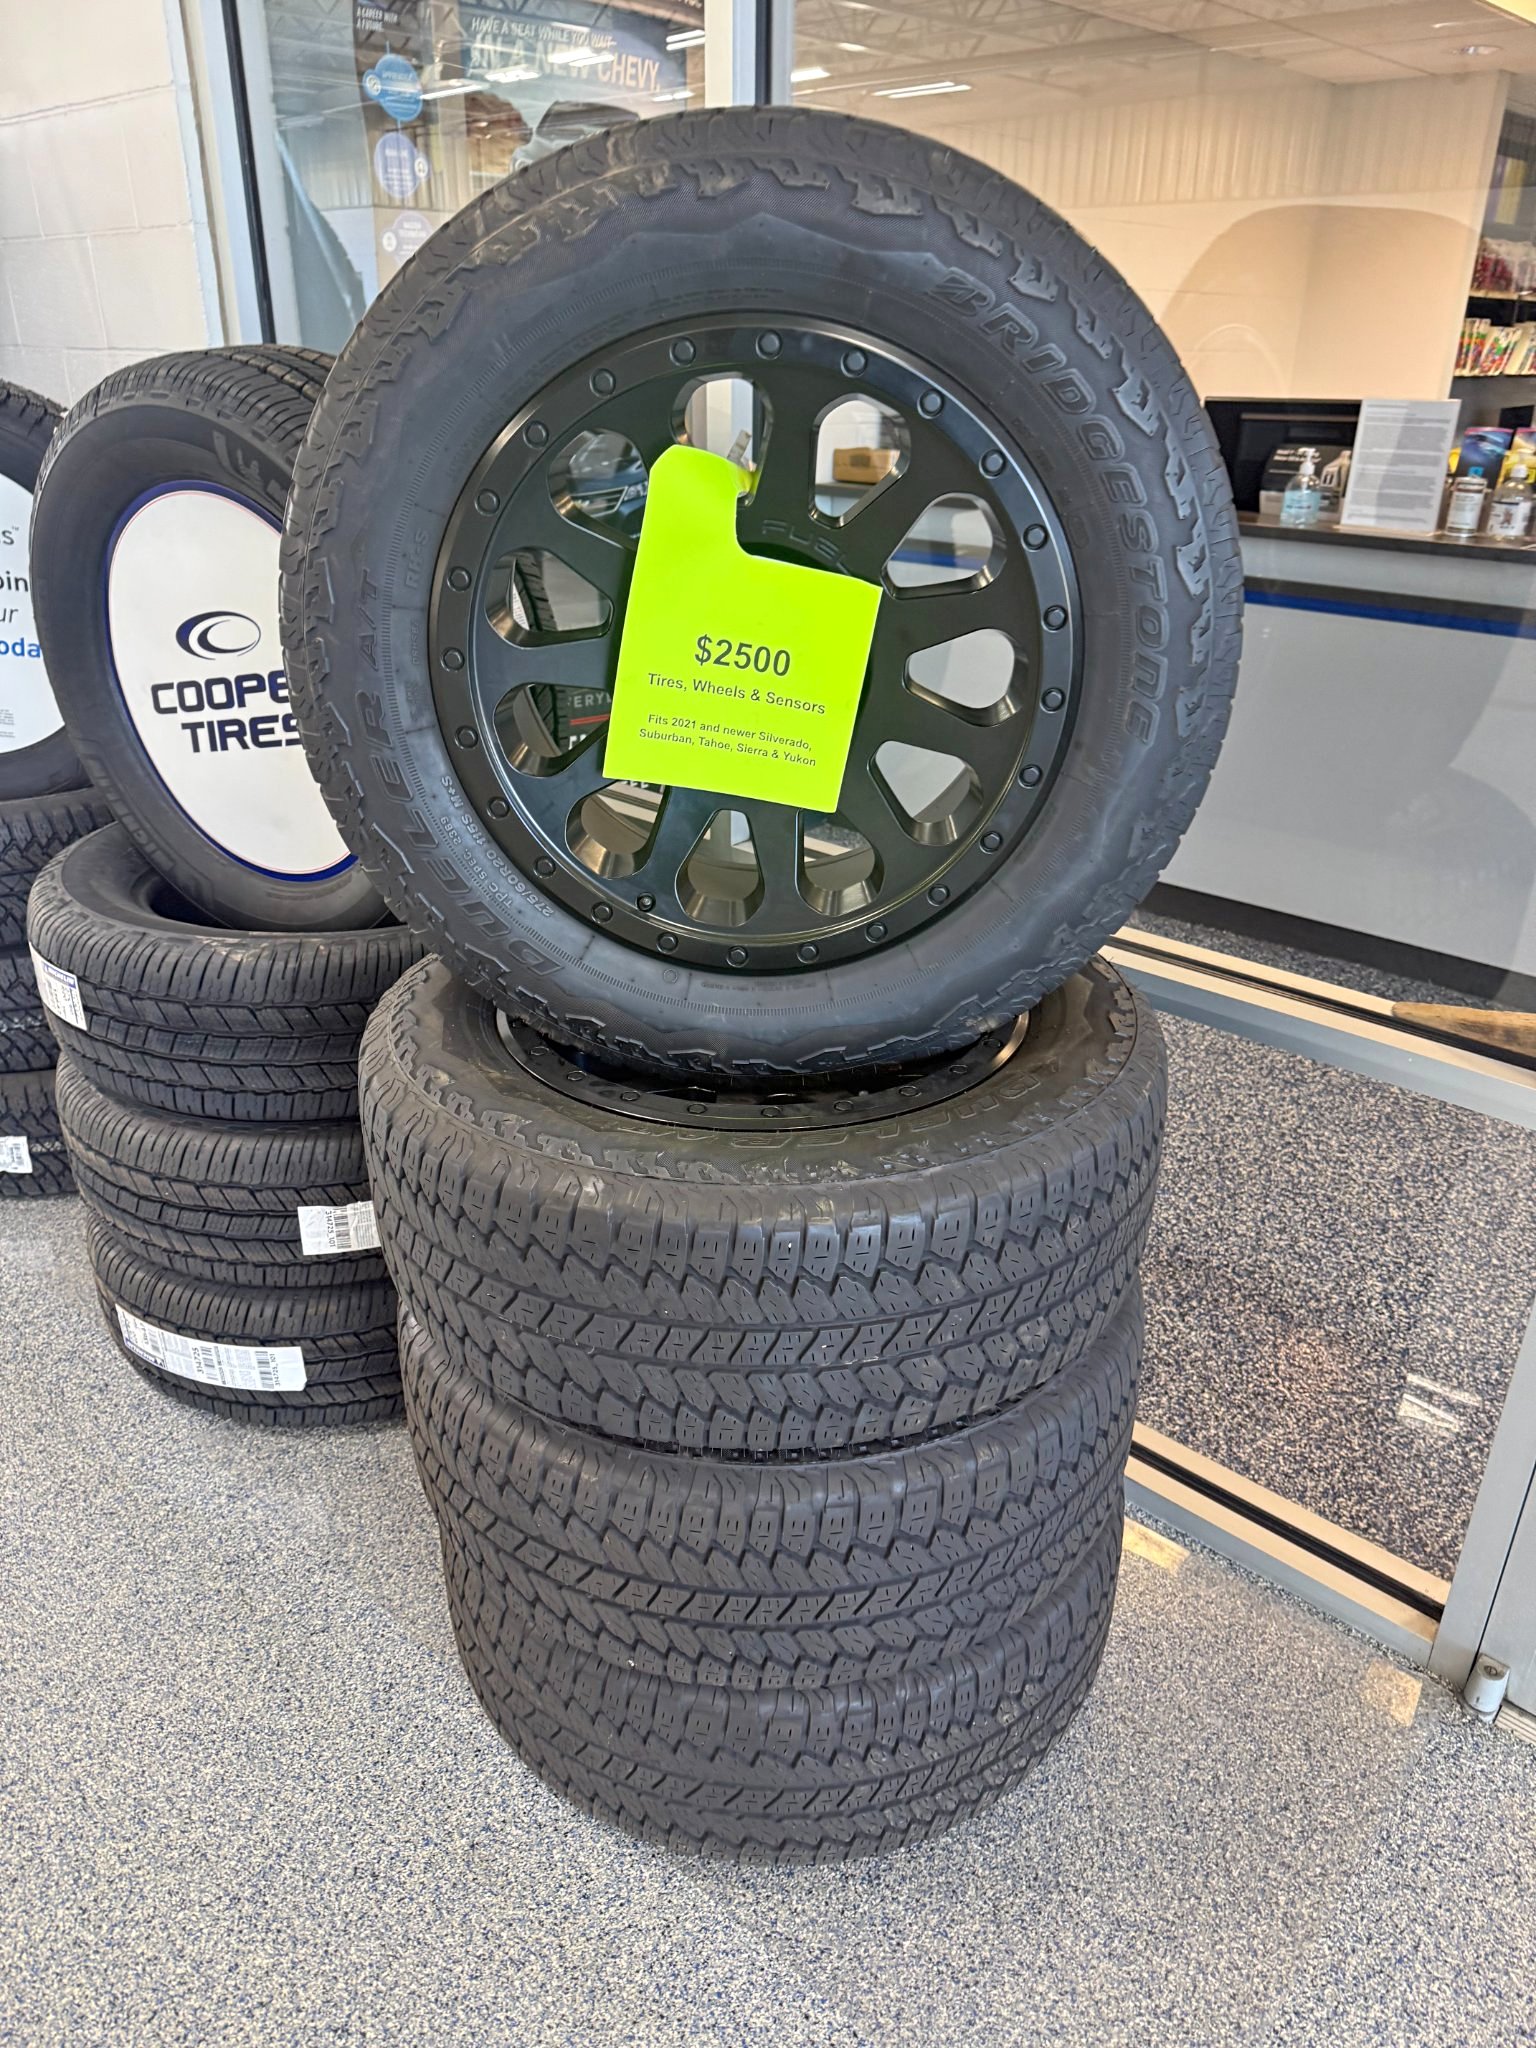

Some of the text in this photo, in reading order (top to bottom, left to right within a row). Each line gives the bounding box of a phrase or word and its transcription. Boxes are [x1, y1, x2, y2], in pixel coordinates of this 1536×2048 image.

[471, 16, 501, 34] HAVE
[501, 20, 509, 35] A
[510, 21, 536, 38] SEAT
[538, 24, 570, 42] WHILE
[571, 30, 589, 46] YOU
[536, 41, 590, 80] NEW
[928, 266, 1169, 746] BRIDGESTONE
[694, 634, 791, 677] $2500
[151, 670, 291, 714] COOPE
[648, 672, 826, 715] Tires, Wheels & Sensors
[181, 713, 303, 753] TIRES
[639, 728, 816, 767] Suburban, Tahoe, Sierra & Yukon
[648, 714, 812, 751] Fits 2021 and newer Silverado,
[355, 567, 565, 976] DUELER A/T
[441, 774, 555, 918] 275/60R20 115S M+S
[464, 848, 488, 881] SPEC.
[488, 881, 513, 909] TPC
[325, 1210, 336, 1247] 314725_101
[192, 1347, 205, 1375] 314725
